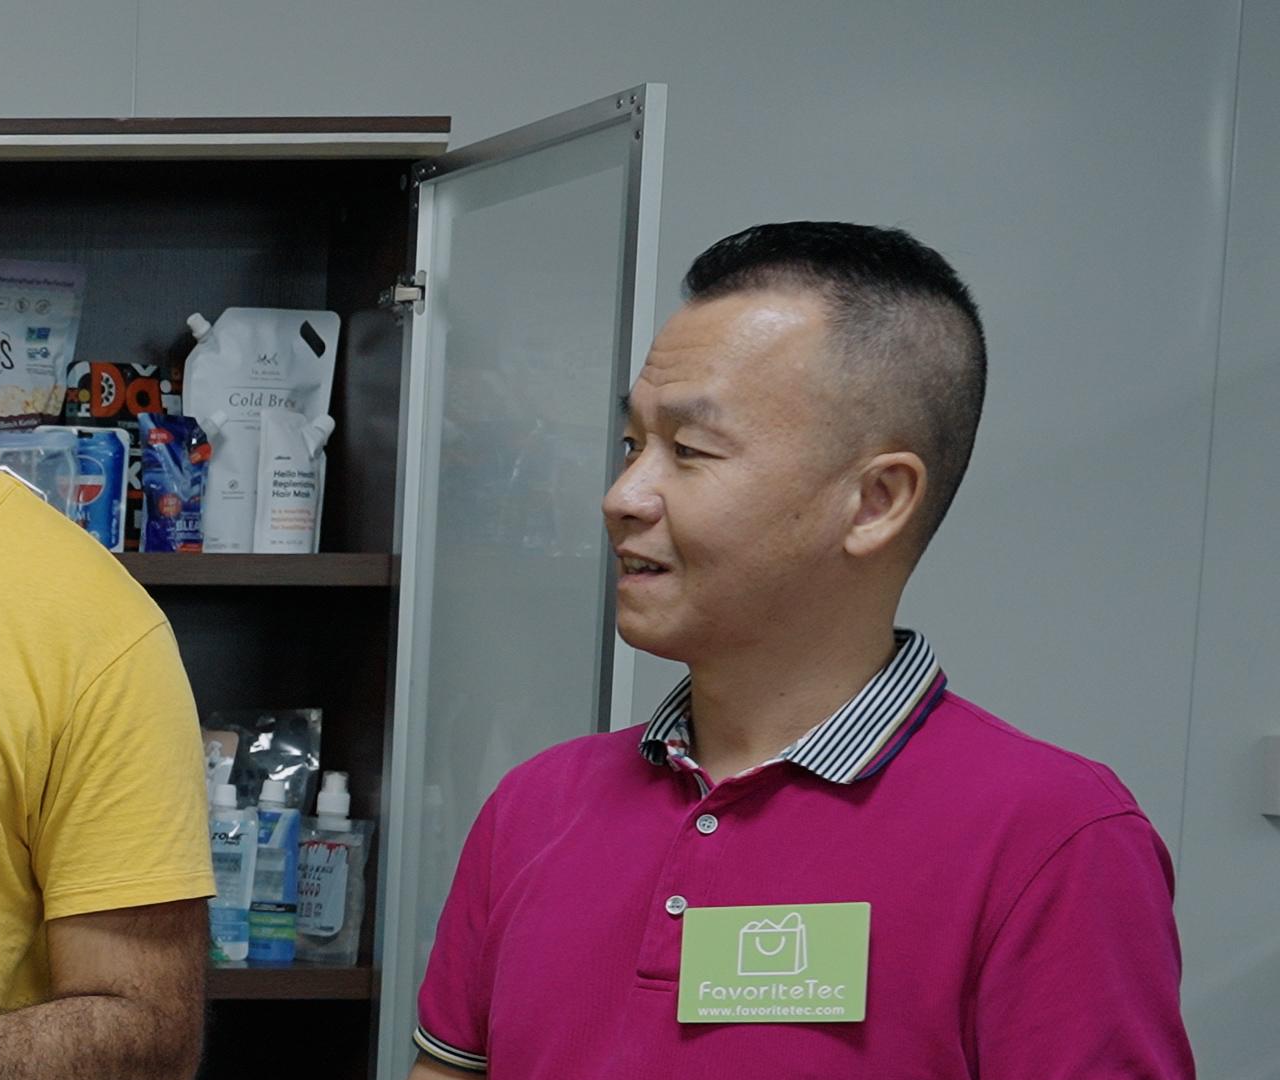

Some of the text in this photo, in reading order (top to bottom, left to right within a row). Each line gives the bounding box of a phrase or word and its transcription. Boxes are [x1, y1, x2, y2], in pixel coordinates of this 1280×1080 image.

[228, 392, 263, 408] Cold
[698, 979, 846, 1001] FavoriteTec
[697, 1004, 845, 1017] www.favoritetec.com
